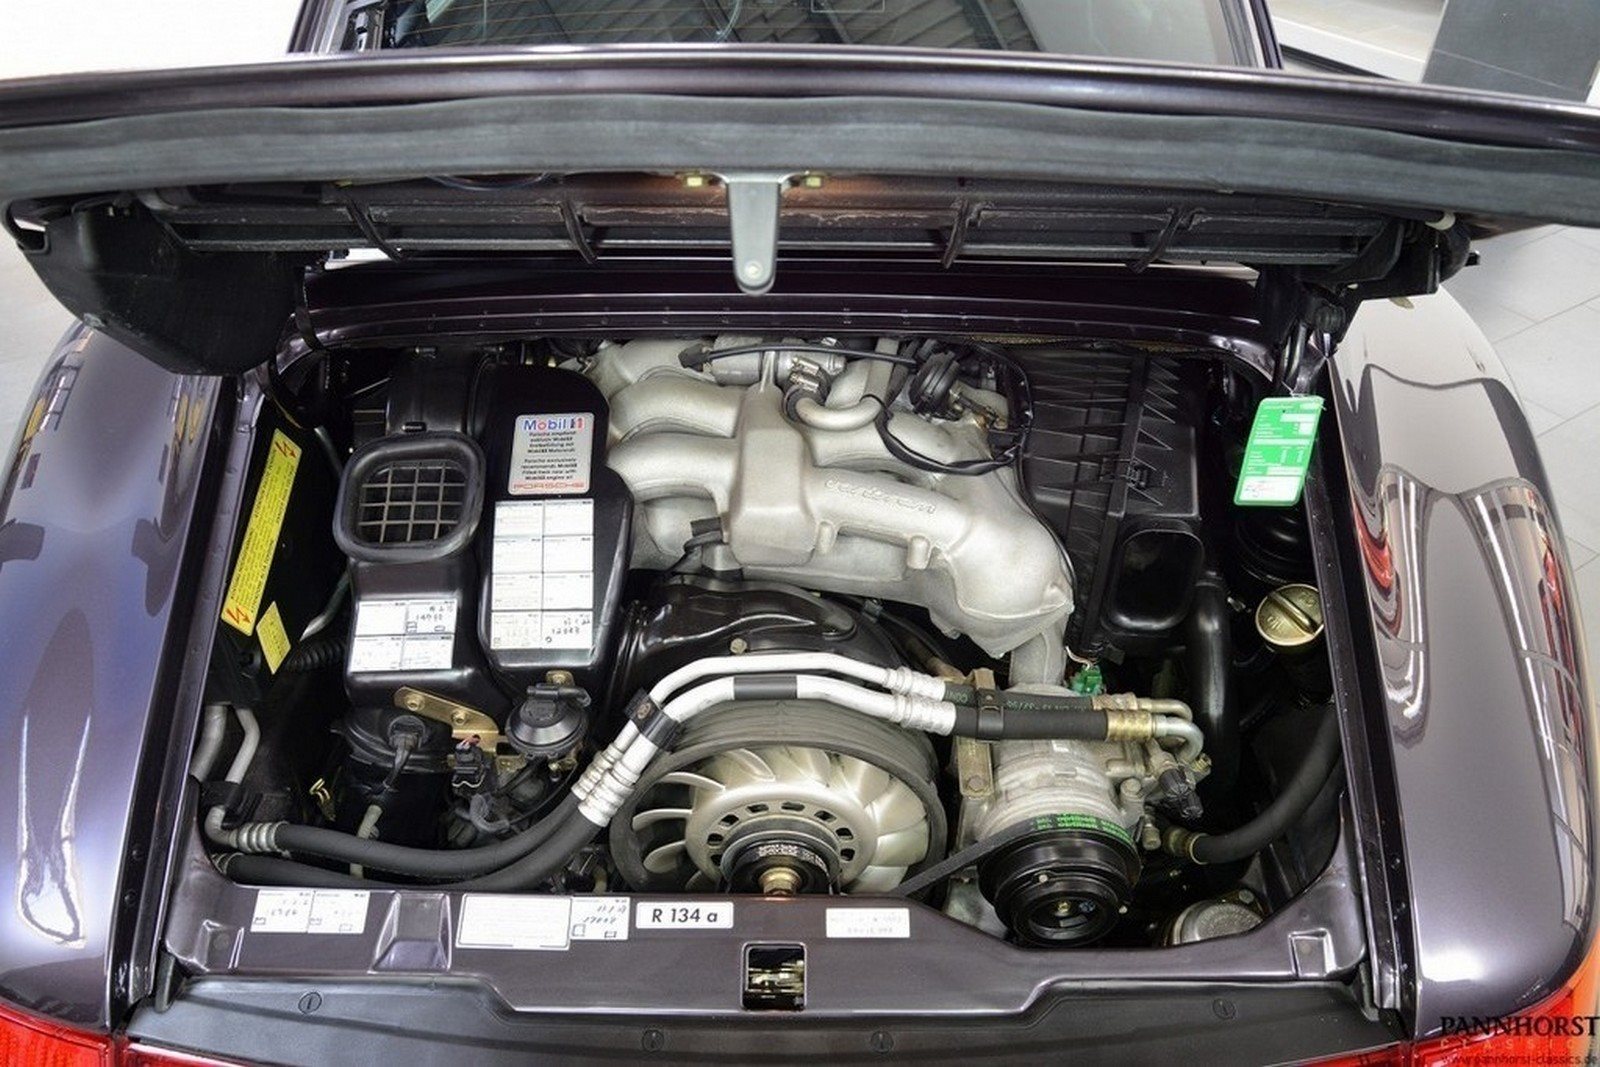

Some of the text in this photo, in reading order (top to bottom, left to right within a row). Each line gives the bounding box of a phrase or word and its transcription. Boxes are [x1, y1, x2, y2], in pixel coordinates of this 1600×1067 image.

[523, 419, 567, 430] Mobil
[651, 908, 718, 922] R 134 a
